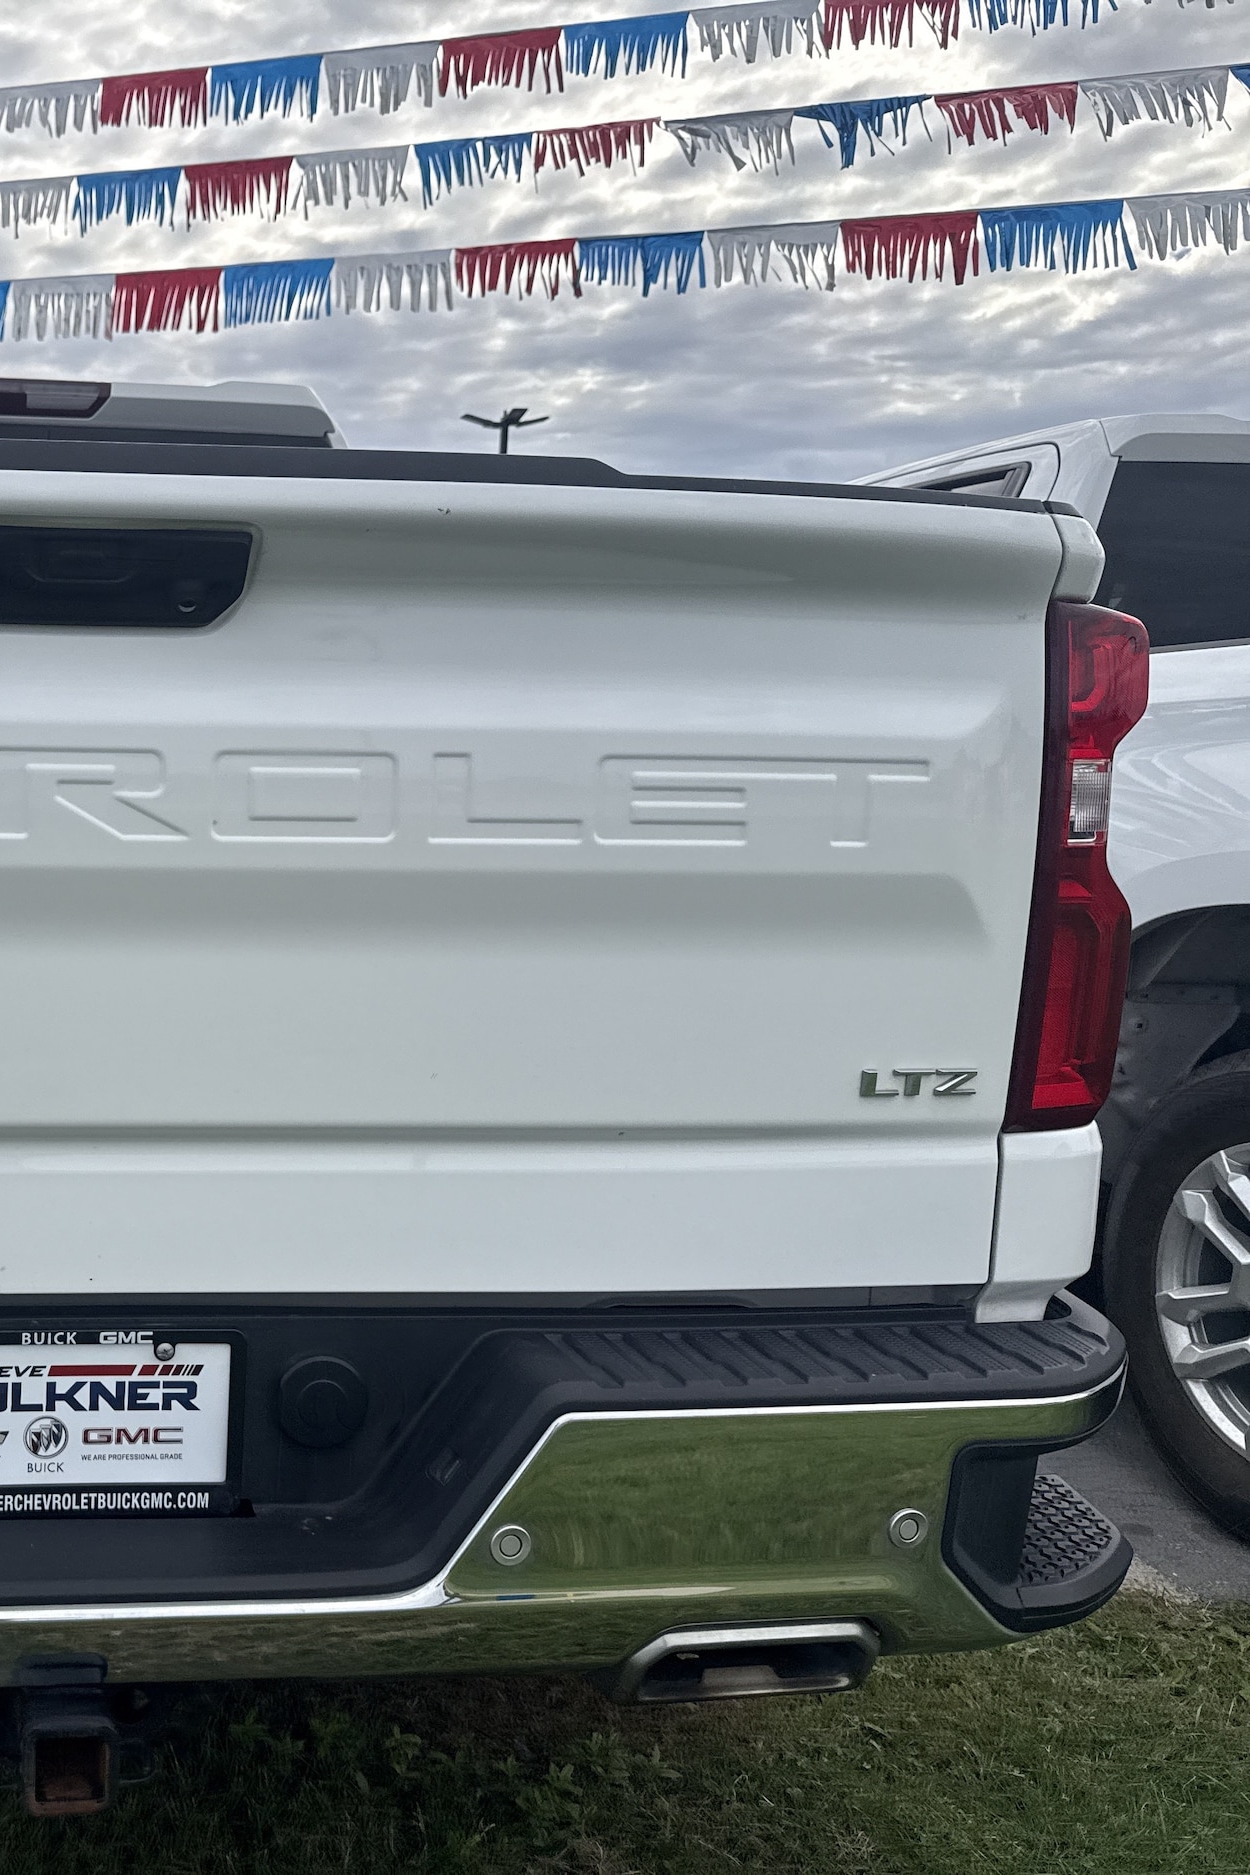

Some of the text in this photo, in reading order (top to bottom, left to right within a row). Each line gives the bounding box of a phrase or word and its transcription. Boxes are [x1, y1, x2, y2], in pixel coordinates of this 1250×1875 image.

[860, 1068, 979, 1098] LTZ
[21, 1331, 154, 1346] BUICK GMC
[81, 1426, 184, 1446] GMC
[92, 1453, 107, 1461] ARE
[107, 1453, 159, 1461] PROFESSIONAL
[159, 1452, 183, 1460] GRADE
[26, 1461, 65, 1474] BUICK
